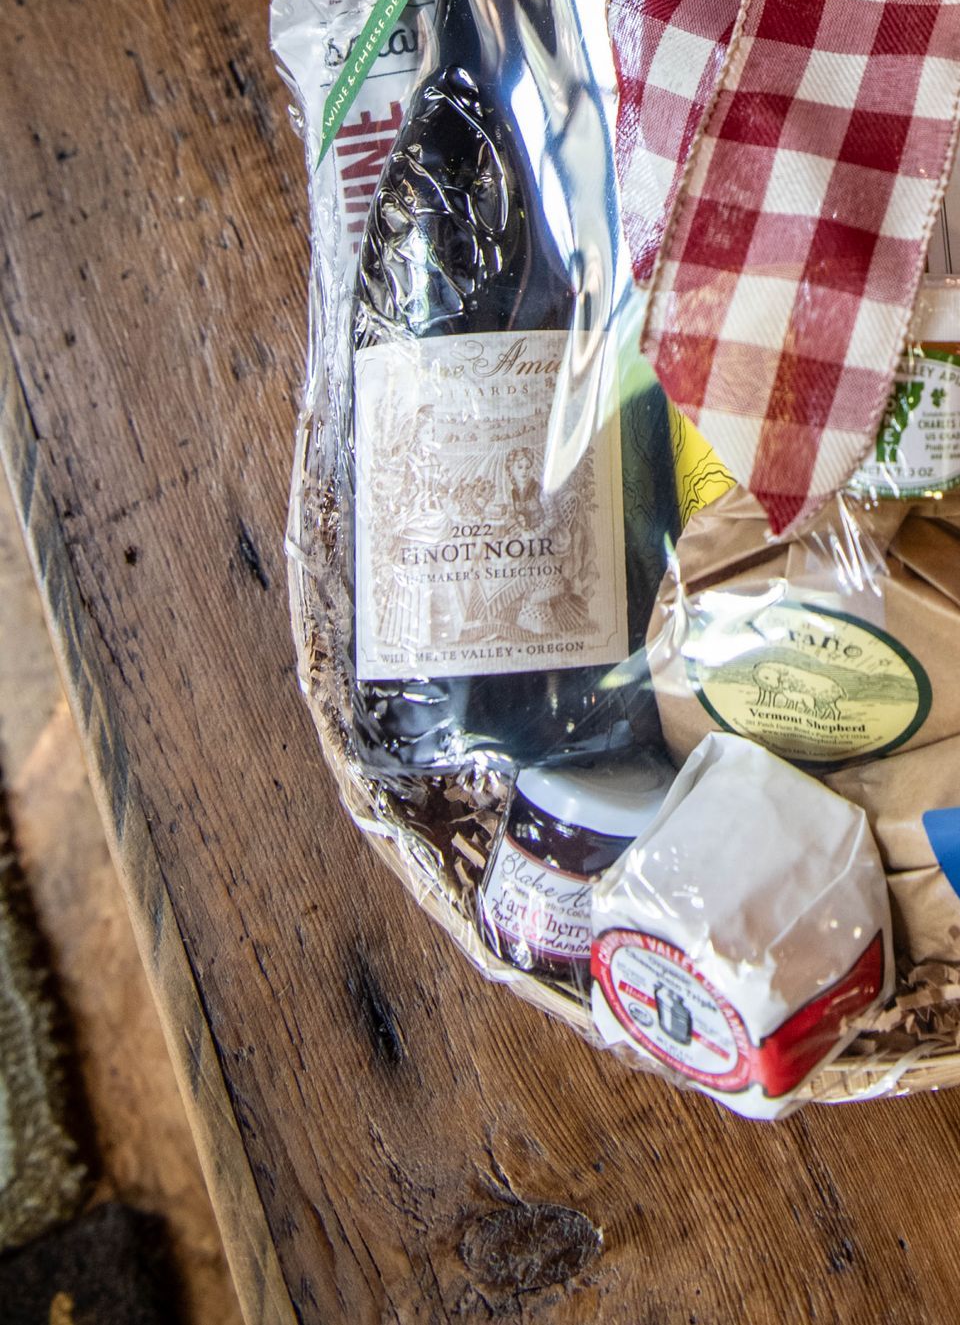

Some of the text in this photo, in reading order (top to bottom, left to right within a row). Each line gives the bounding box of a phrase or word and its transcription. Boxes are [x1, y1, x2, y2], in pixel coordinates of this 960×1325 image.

[324, 86, 349, 128] WINE
[353, 18, 386, 75] CHEESE
[452, 523, 494, 539] 2022
[401, 537, 556, 566] PINOT NOIR
[484, 563, 564, 581] SELECTION
[460, 646, 514, 661] VALLEY
[526, 641, 585, 656] OREGON
[749, 706, 866, 734] Vermont Shepherd
[502, 851, 558, 897] Blake
[531, 909, 591, 944] Cherry
